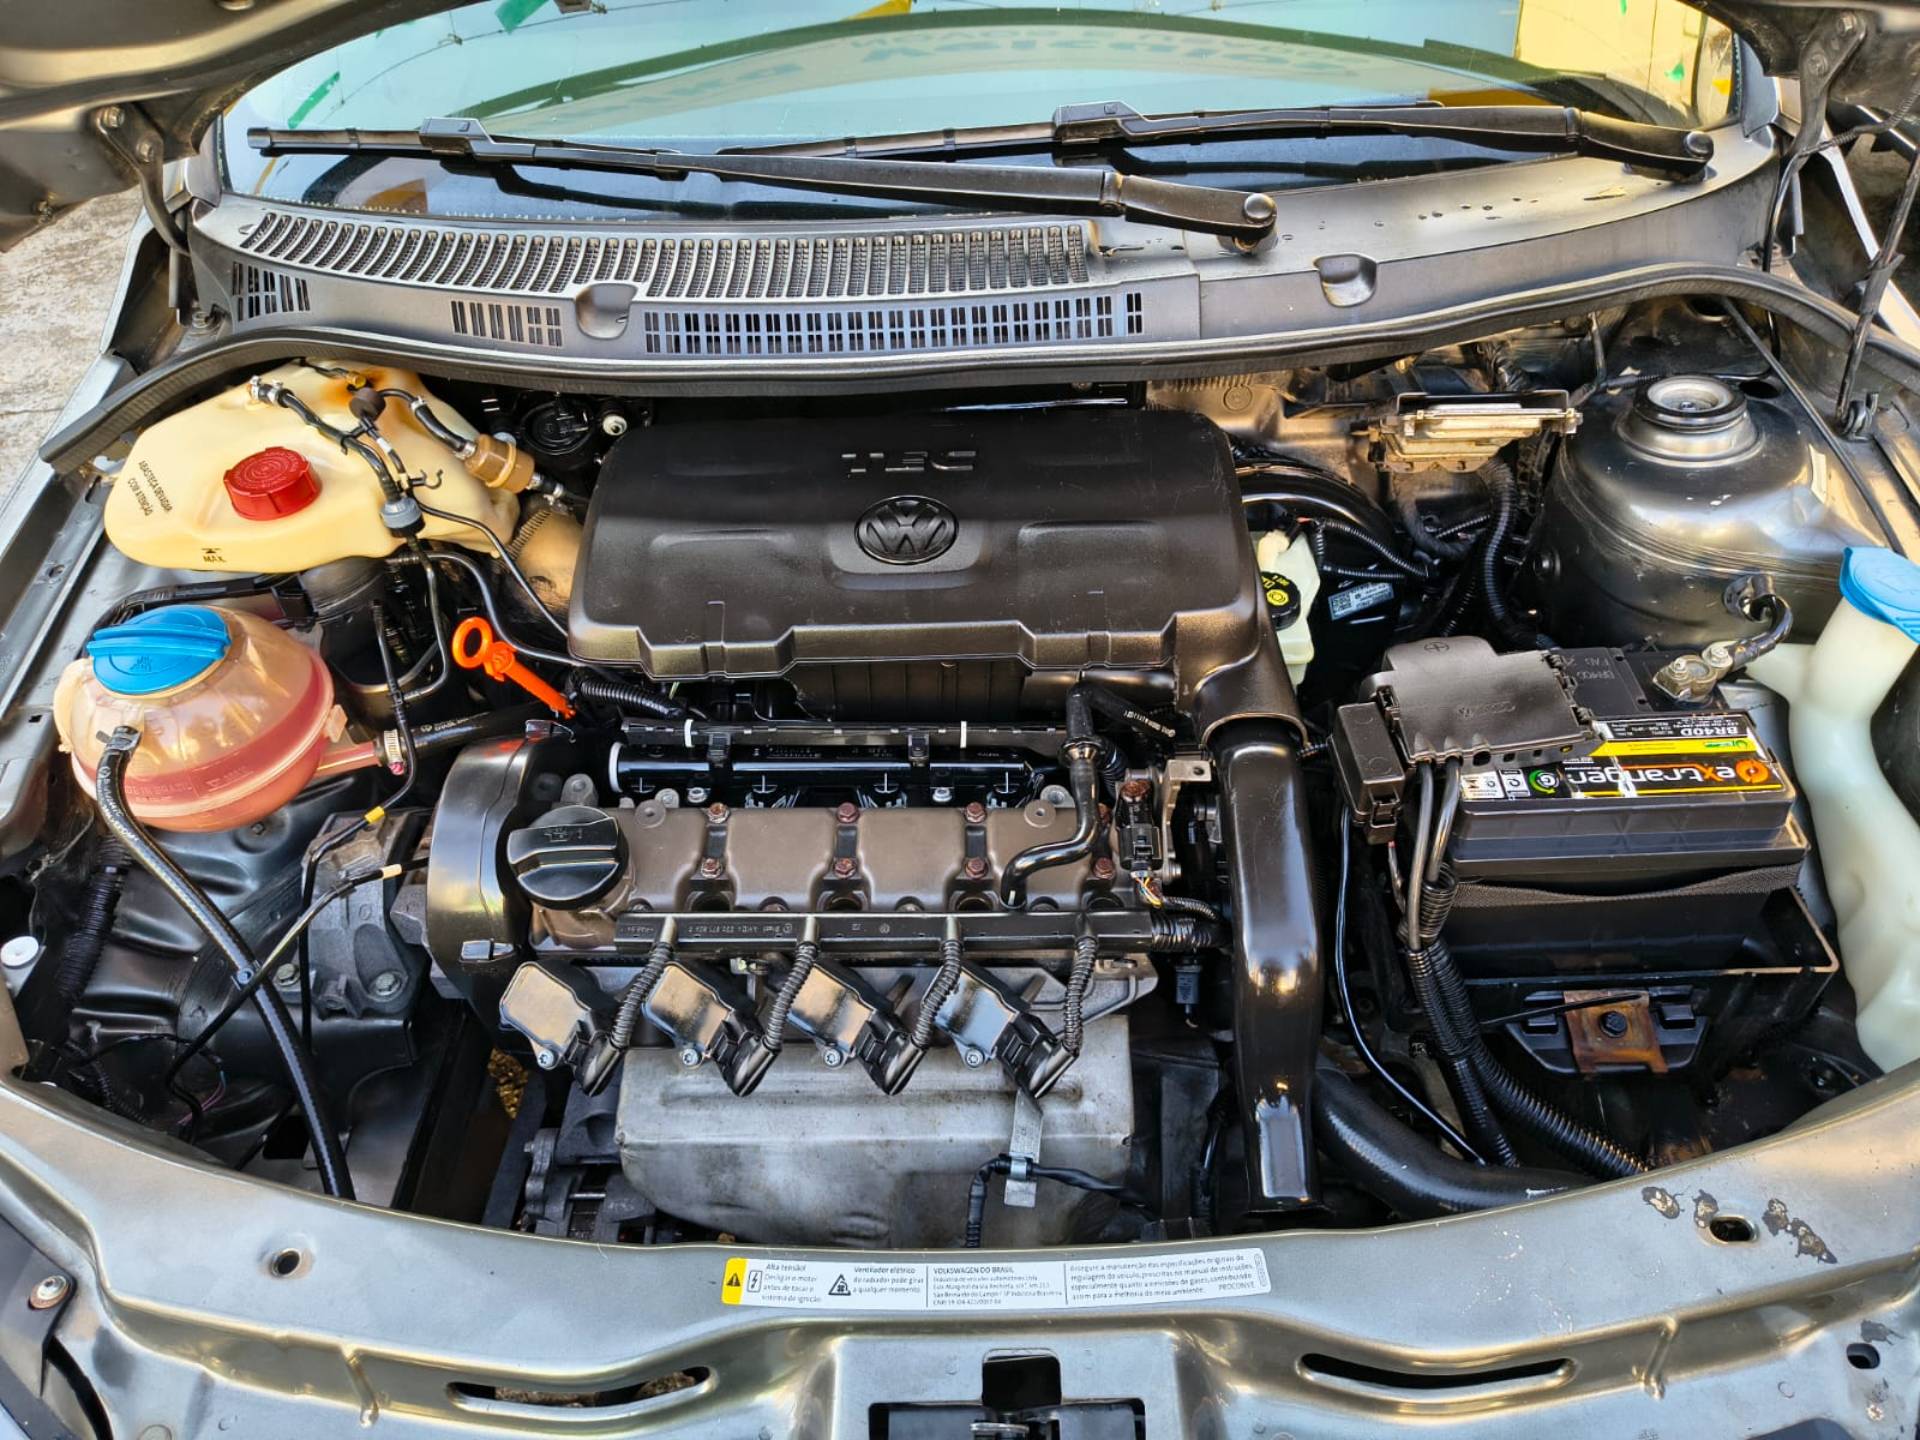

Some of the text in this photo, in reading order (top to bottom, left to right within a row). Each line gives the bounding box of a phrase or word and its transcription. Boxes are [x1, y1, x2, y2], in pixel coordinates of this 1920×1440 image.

[1679, 724, 1740, 738] BR40D
[766, 1263, 780, 1271] Alta
[854, 1266, 889, 1274] Ventilador
[933, 1266, 1015, 1274] VOLKSWAGEN DO BRASIL
